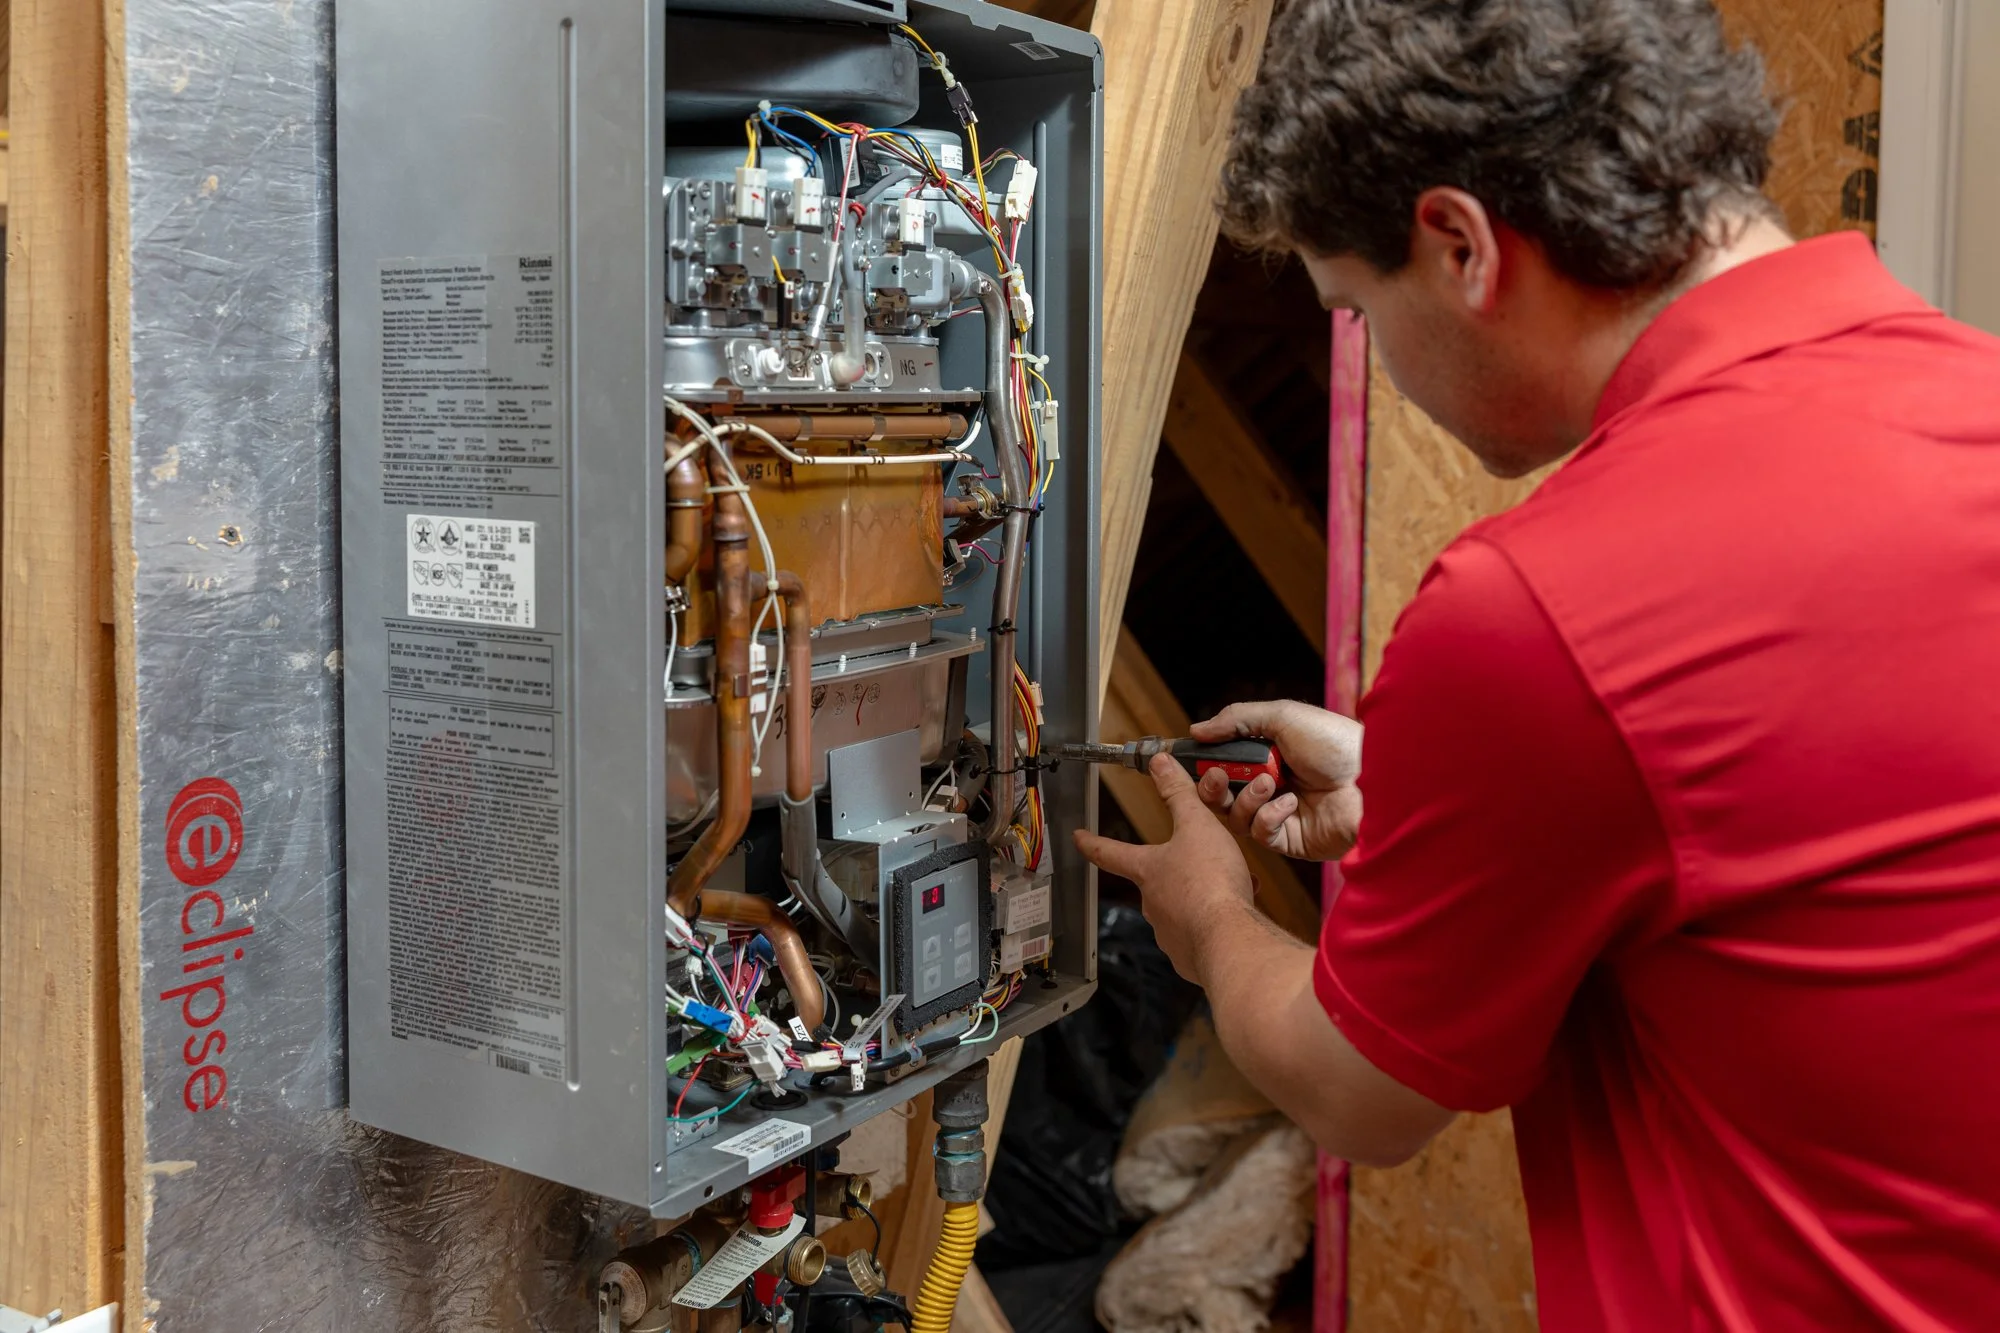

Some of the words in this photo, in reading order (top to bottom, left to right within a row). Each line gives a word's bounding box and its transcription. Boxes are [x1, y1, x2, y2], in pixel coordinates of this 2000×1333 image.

[900, 359, 916, 376] NG
[160, 777, 254, 1113] eclipse
[736, 1230, 762, 1247] Webstone
[677, 1297, 708, 1309] WARNING
